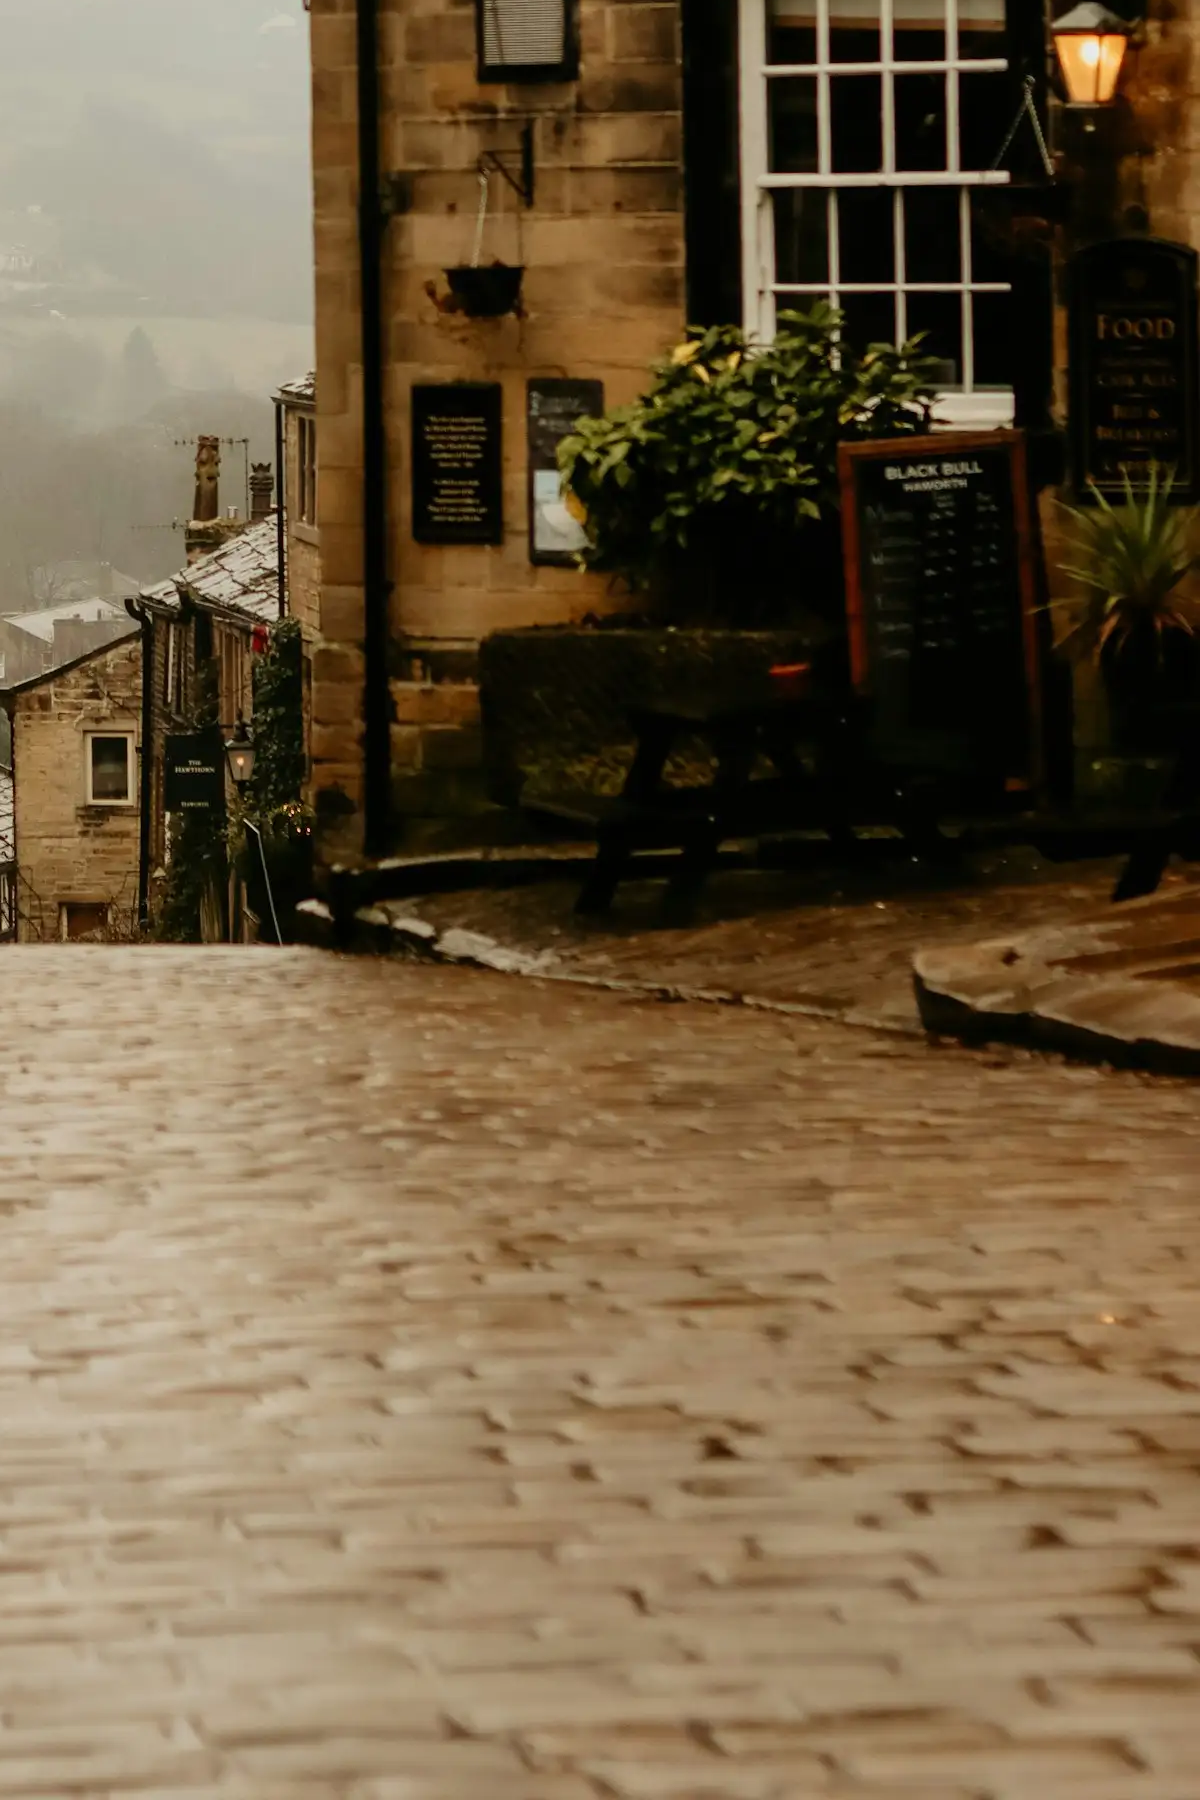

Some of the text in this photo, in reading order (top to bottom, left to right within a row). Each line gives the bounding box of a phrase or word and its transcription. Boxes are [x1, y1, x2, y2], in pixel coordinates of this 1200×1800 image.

[1095, 313, 1176, 340] FOOD
[883, 460, 985, 481] BLACK BULL
[902, 478, 968, 492] HAWORTH
